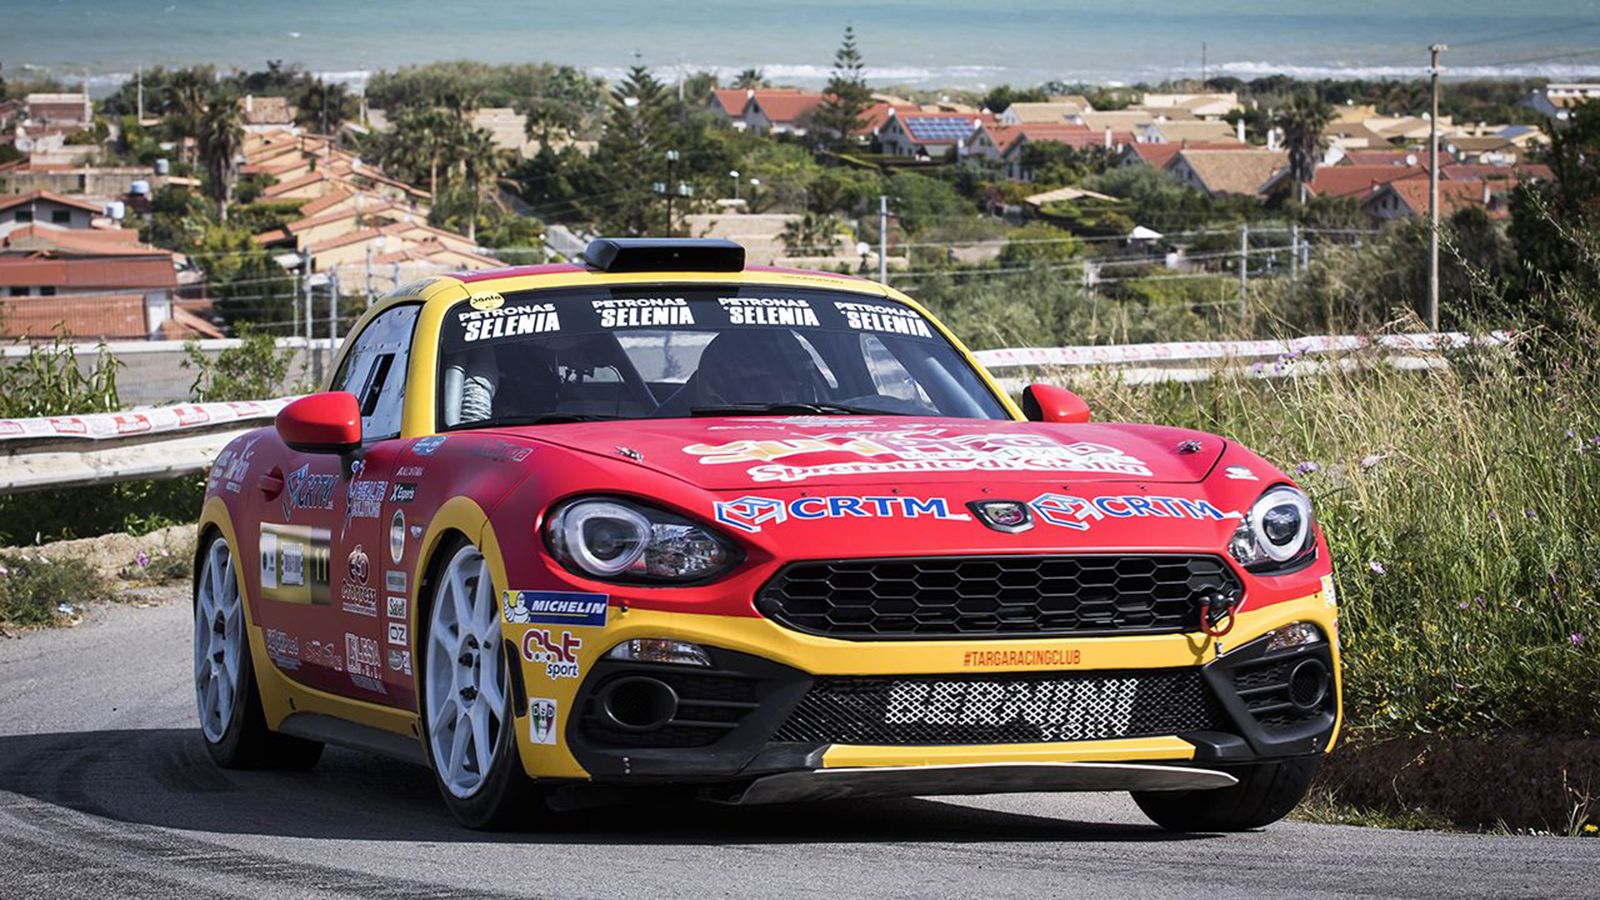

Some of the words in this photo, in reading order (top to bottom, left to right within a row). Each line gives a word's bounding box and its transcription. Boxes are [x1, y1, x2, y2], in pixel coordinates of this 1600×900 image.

[458, 303, 556, 321] PETRONAS
[592, 298, 688, 309] PETRONAS
[718, 298, 810, 309] PETRONAS
[834, 302, 920, 319] PETRONAS
[600, 307, 695, 328] SELENIA
[729, 306, 820, 327] SELENIA
[846, 311, 933, 338] SELENIA
[463, 312, 560, 342] SELENIA
[789, 496, 949, 519] CRTM
[1093, 496, 1224, 520] CRTM
[531, 600, 606, 615] MICHELIN
[390, 626, 405, 641] OZ
[963, 650, 1081, 667] #TARGARACINGCLUB
[546, 662, 579, 678] sport
